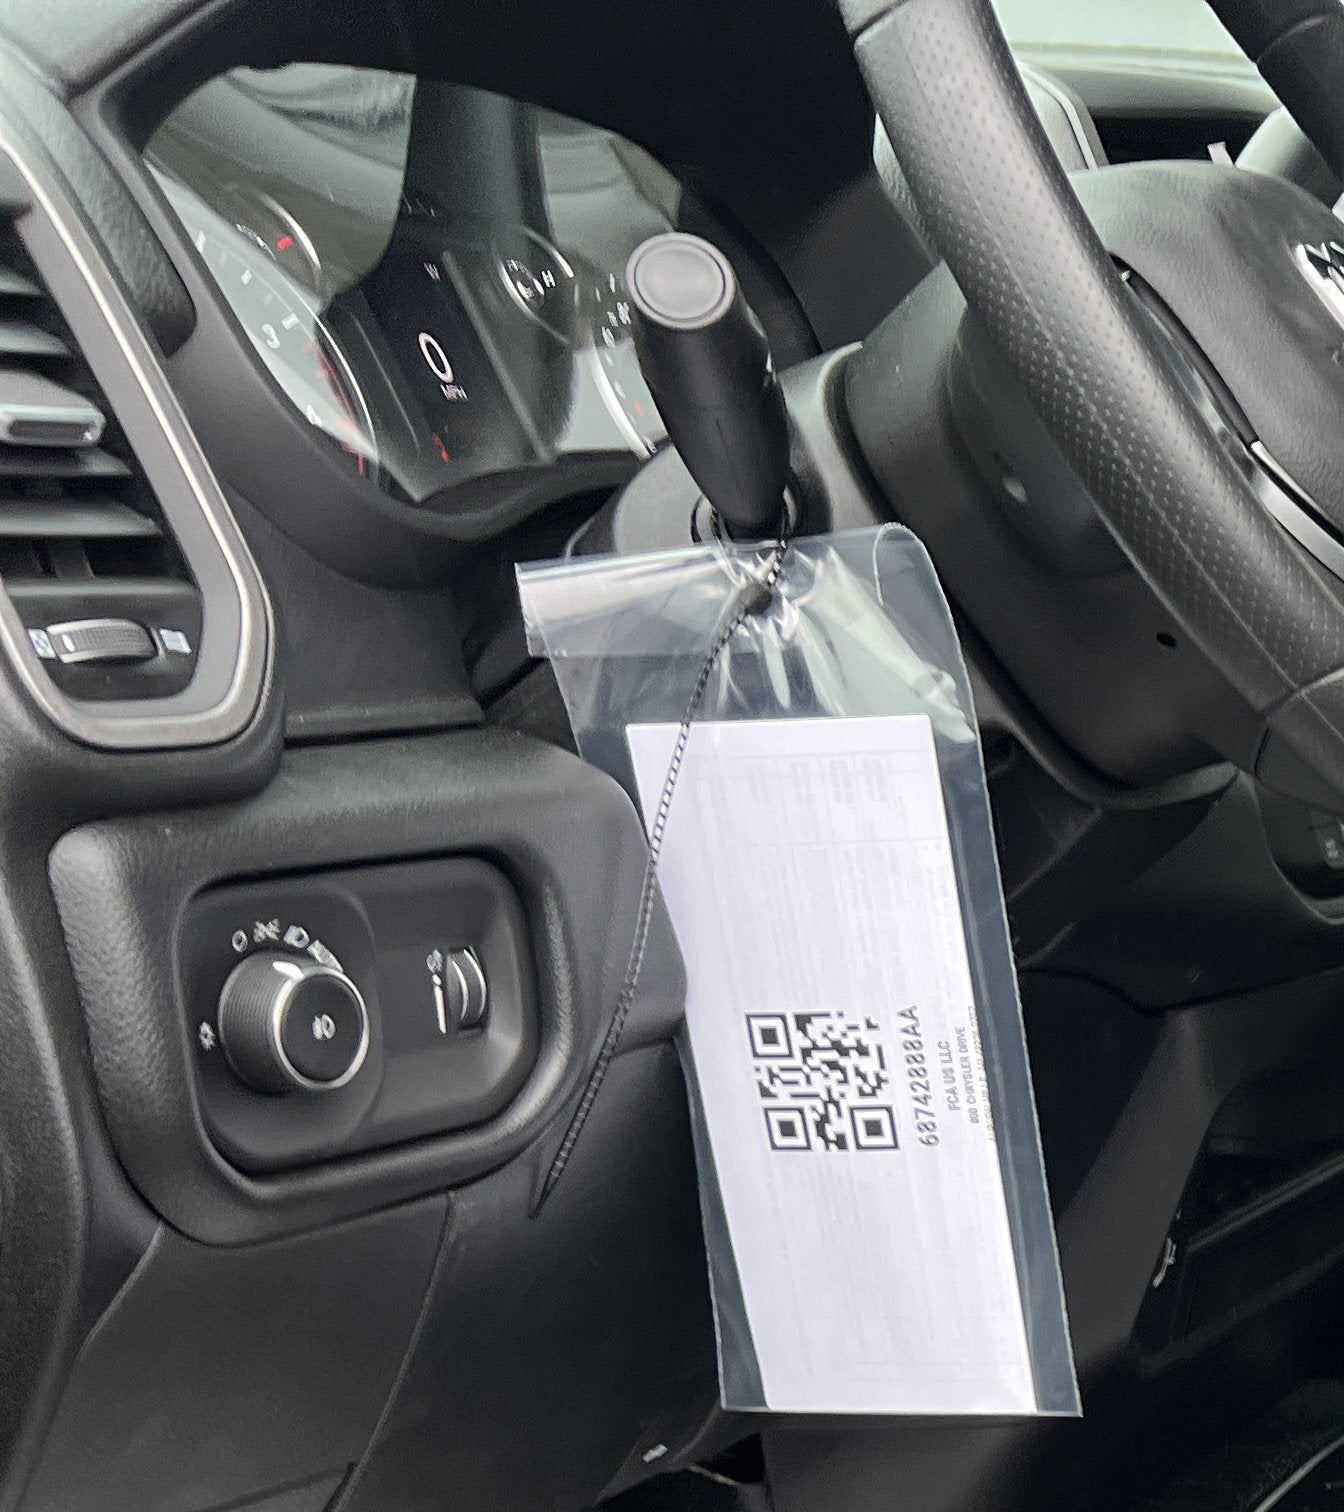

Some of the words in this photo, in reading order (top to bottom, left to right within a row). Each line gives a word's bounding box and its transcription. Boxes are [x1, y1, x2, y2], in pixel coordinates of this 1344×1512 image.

[937, 1040, 953, 1064] LLC
[955, 1026, 969, 1053] DRIVE
[897, 1005, 940, 1146] 68742888AA
[941, 1066, 956, 1085] US
[960, 1056, 977, 1105] CHRYSLER
[945, 1086, 961, 1111] FCA
